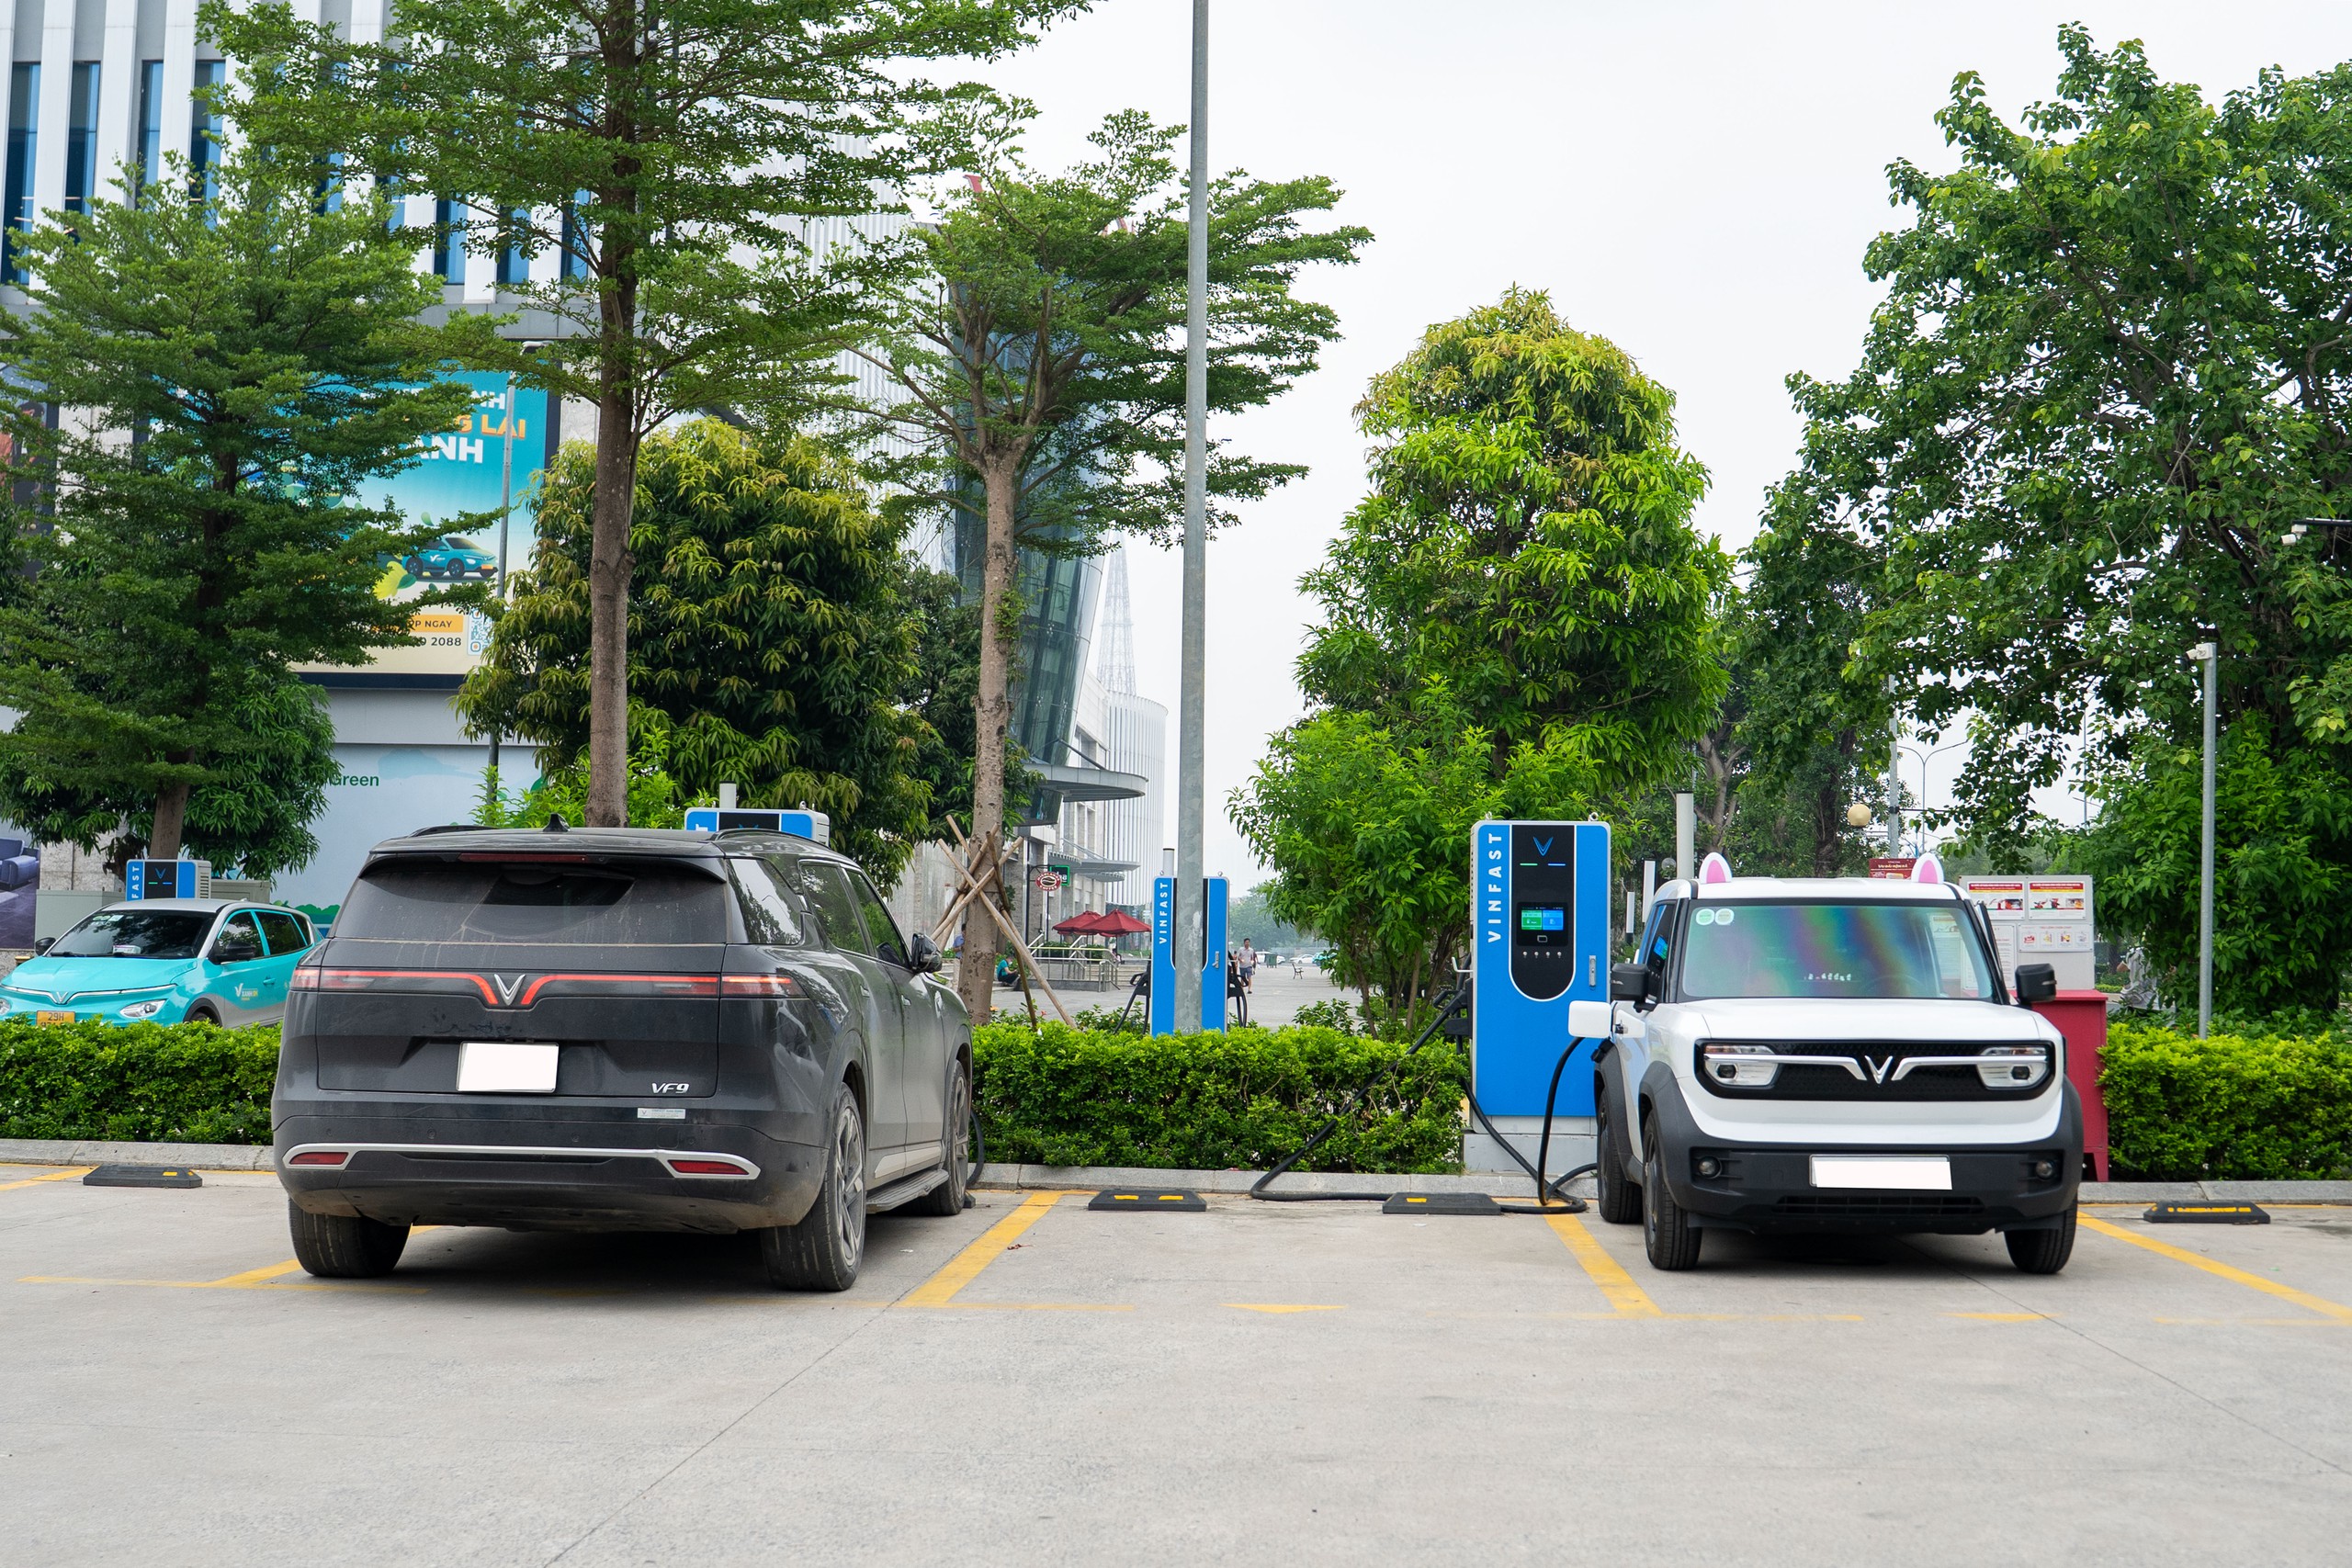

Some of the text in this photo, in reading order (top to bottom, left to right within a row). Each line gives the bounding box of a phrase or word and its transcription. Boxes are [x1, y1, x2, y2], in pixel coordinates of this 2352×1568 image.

[382, 434, 484, 464] ANH
[424, 619, 453, 628] NGAY
[431, 637, 462, 647] 2088
[1487, 832, 1502, 943] VINFAST
[1159, 882, 1168, 945] VINFAST
[47, 1012, 65, 1021] 29H
[651, 1082, 690, 1094] VF9
